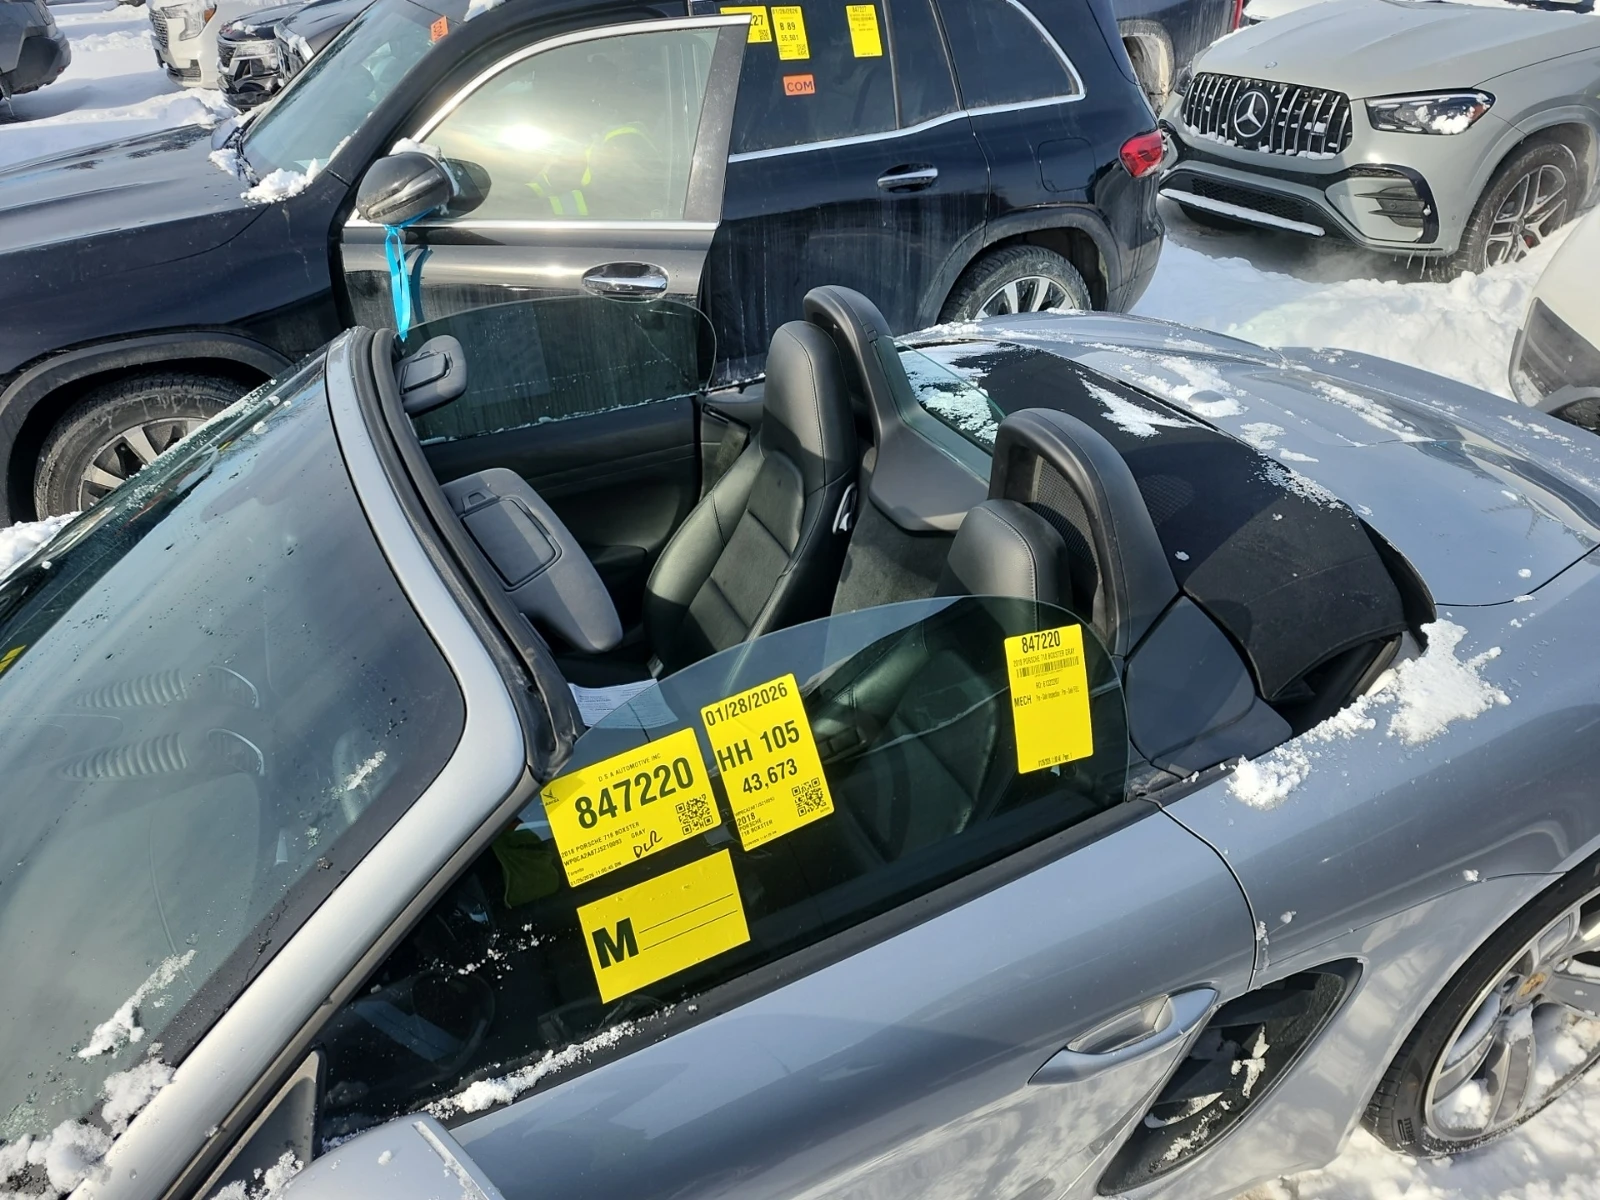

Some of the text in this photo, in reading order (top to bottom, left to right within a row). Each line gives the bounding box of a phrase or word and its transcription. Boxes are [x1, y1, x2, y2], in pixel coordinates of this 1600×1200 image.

[750, 15, 763, 26] 27
[787, 22, 796, 30] 89
[786, 81, 813, 92] COM
[1021, 630, 1061, 654] 847220
[705, 682, 788, 726] 01/28/2026
[1014, 695, 1032, 708] MECH
[717, 720, 800, 772] HH 105
[616, 758, 650, 776] AUTOMOTIVE
[650, 753, 661, 762] INC
[742, 758, 798, 794] 43,673
[574, 757, 694, 829] 847220
[736, 812, 756, 826] 2018
[739, 817, 762, 831] PORSCHE
[751, 819, 773, 835] BOXSTER
[561, 847, 575, 858] 2018
[575, 837, 602, 852] PORSCHE
[615, 822, 640, 836] BOXSTER
[631, 828, 646, 839] GRAY
[591, 917, 639, 970] M
